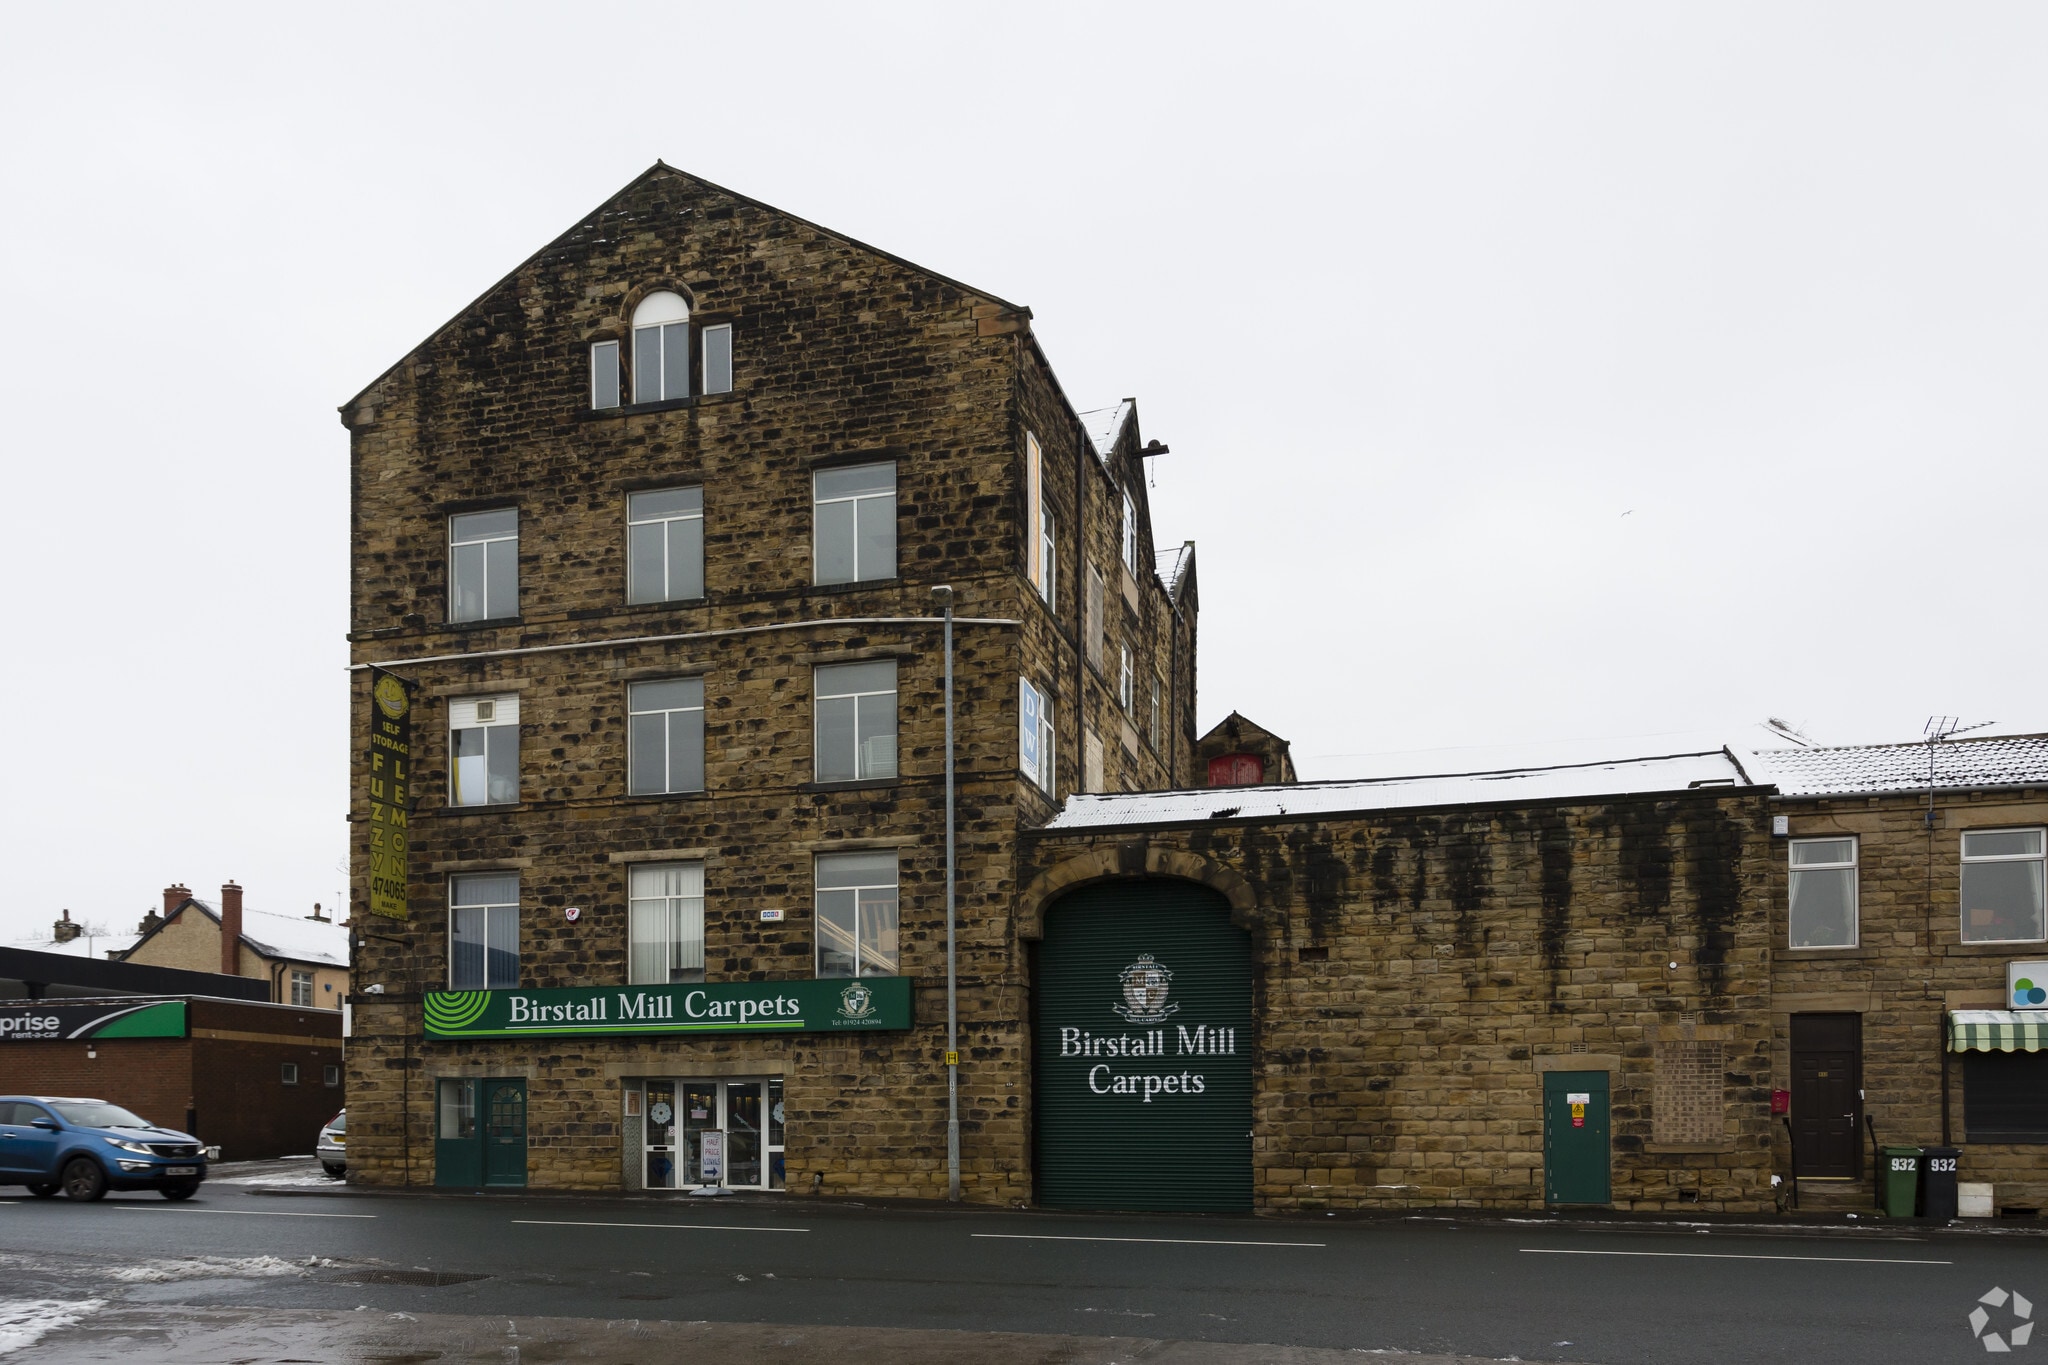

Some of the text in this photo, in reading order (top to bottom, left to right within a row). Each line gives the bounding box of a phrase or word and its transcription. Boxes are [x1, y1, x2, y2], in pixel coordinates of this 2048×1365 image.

[382, 721, 400, 736] SELF
[372, 733, 409, 755] STORAGE
[371, 752, 385, 872] FUZZY
[391, 759, 407, 878] LEMON
[372, 876, 406, 901] 474065
[509, 990, 800, 1025] Birstall Mill Carpets
[0, 1012, 60, 1036] prise
[11, 1031, 60, 1039] rent-a-car
[1059, 1025, 1236, 1057] Birstall Mill
[1088, 1064, 1206, 1103] Carpets
[705, 1148, 720, 1156] PRICE
[1891, 1157, 1916, 1172] 932
[1931, 1158, 1956, 1171] 932
